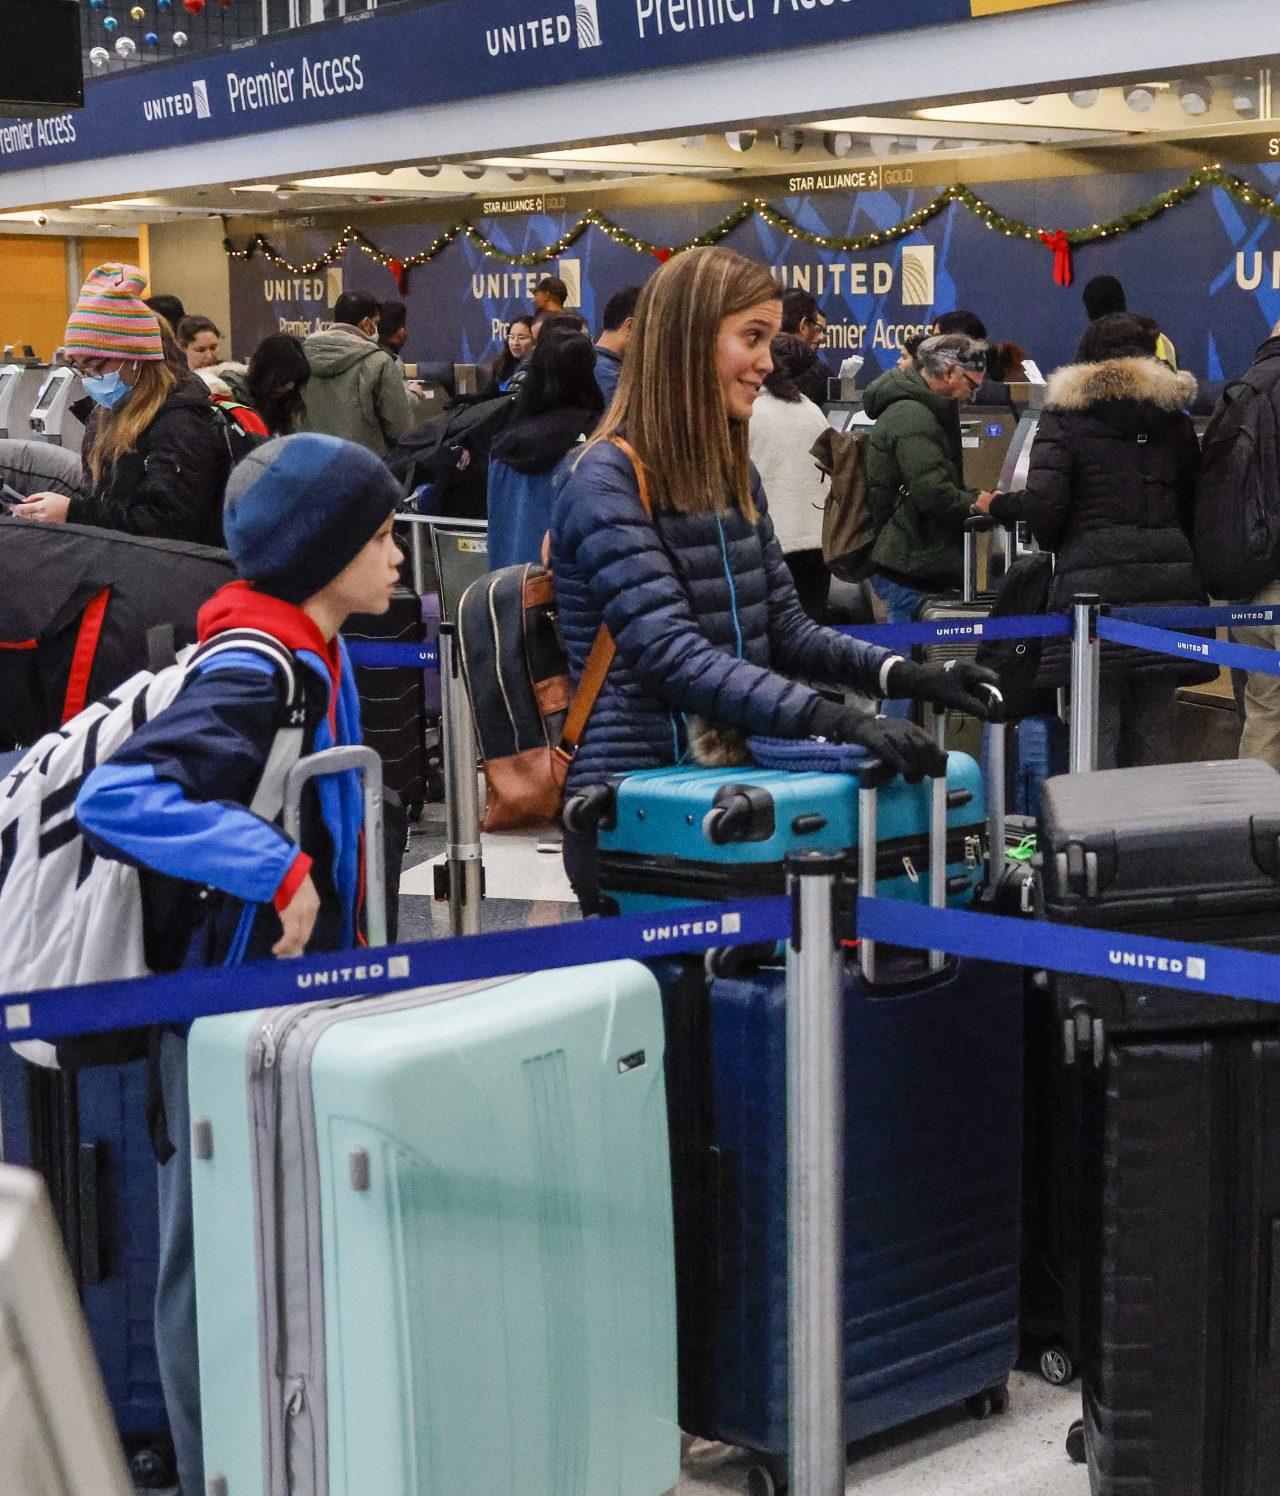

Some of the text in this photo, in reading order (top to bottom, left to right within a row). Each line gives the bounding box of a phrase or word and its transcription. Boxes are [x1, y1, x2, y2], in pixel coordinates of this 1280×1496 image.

[486, 14, 571, 56] UNITED
[143, 54, 364, 121] UNITED Premier Access
[0, 114, 76, 153] remier Access
[789, 169, 913, 192] STAR ALLIANCE GOLD
[483, 202, 500, 214] STAR
[502, 199, 534, 212] ALLIANCE
[264, 279, 324, 302] UNITED
[472, 272, 552, 299] UNITE
[936, 627, 973, 636] UNITED
[1177, 641, 1202, 652] UNITED
[642, 920, 719, 942] UNITED
[1108, 950, 1183, 973] UNITED
[297, 964, 384, 988] UNITED
